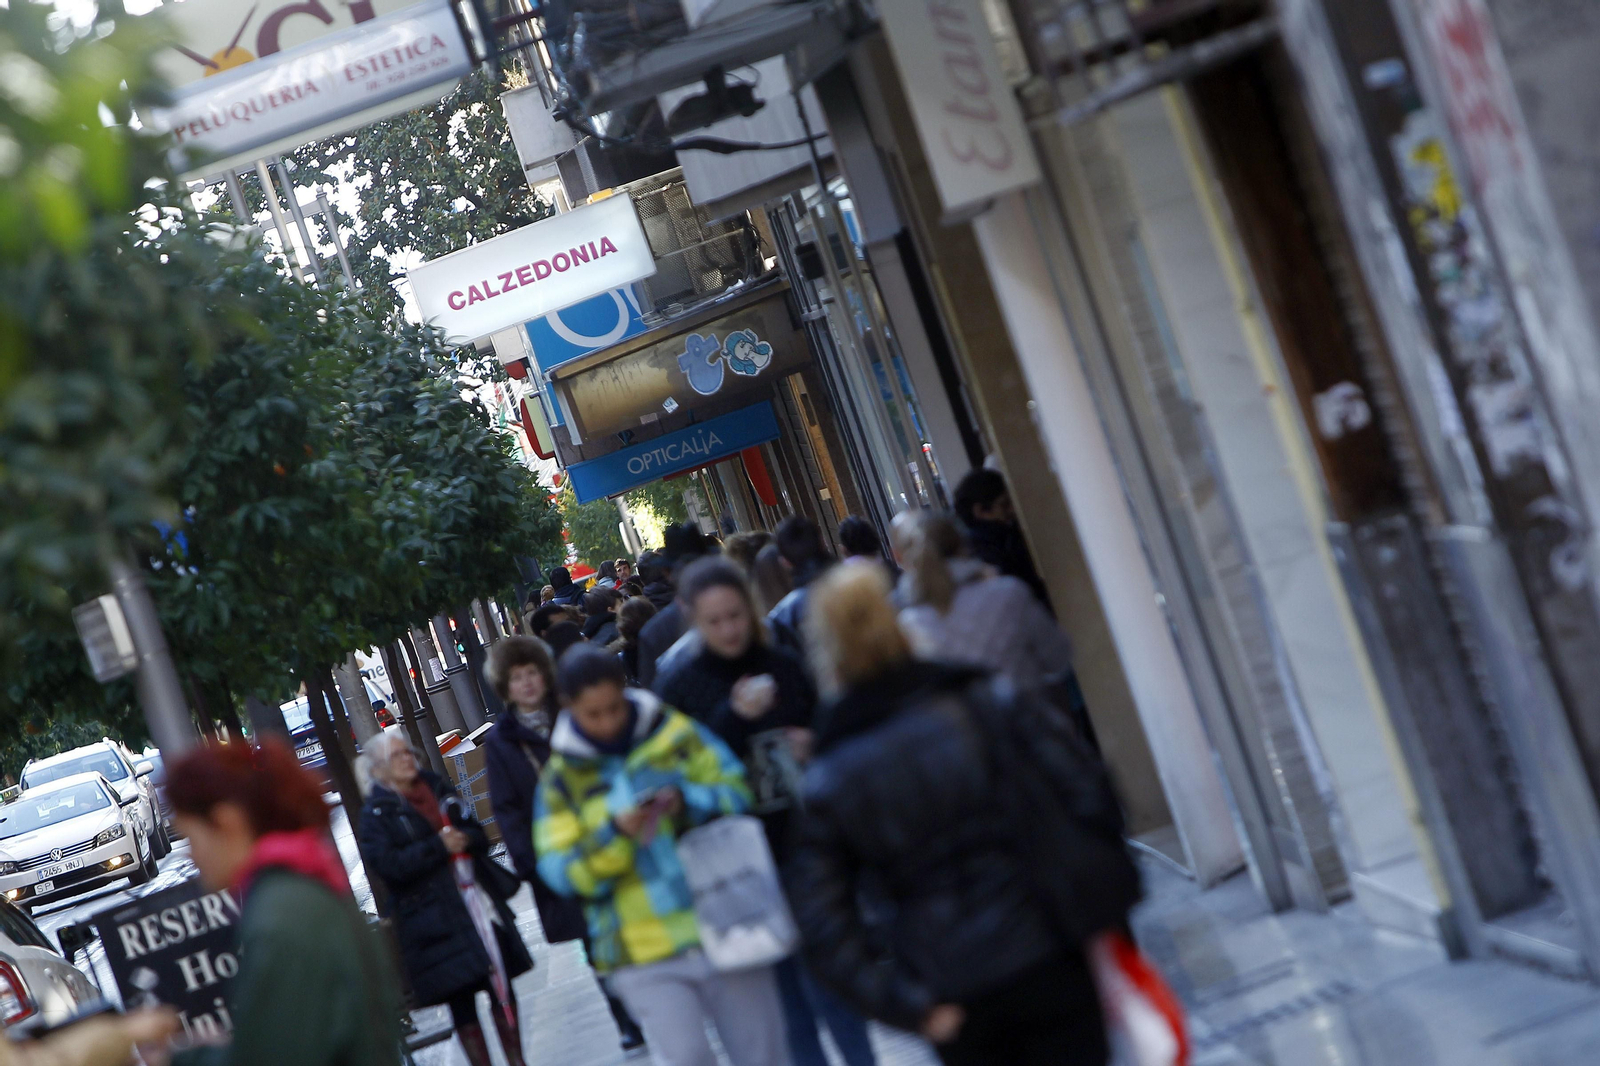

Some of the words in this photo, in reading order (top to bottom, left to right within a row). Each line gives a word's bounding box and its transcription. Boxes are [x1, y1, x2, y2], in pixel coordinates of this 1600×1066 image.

[343, 32, 446, 82] ESTETICA
[447, 235, 619, 311] CALZEDONIA
[296, 745, 316, 758] 7789
[65, 860, 80, 871] HNJ
